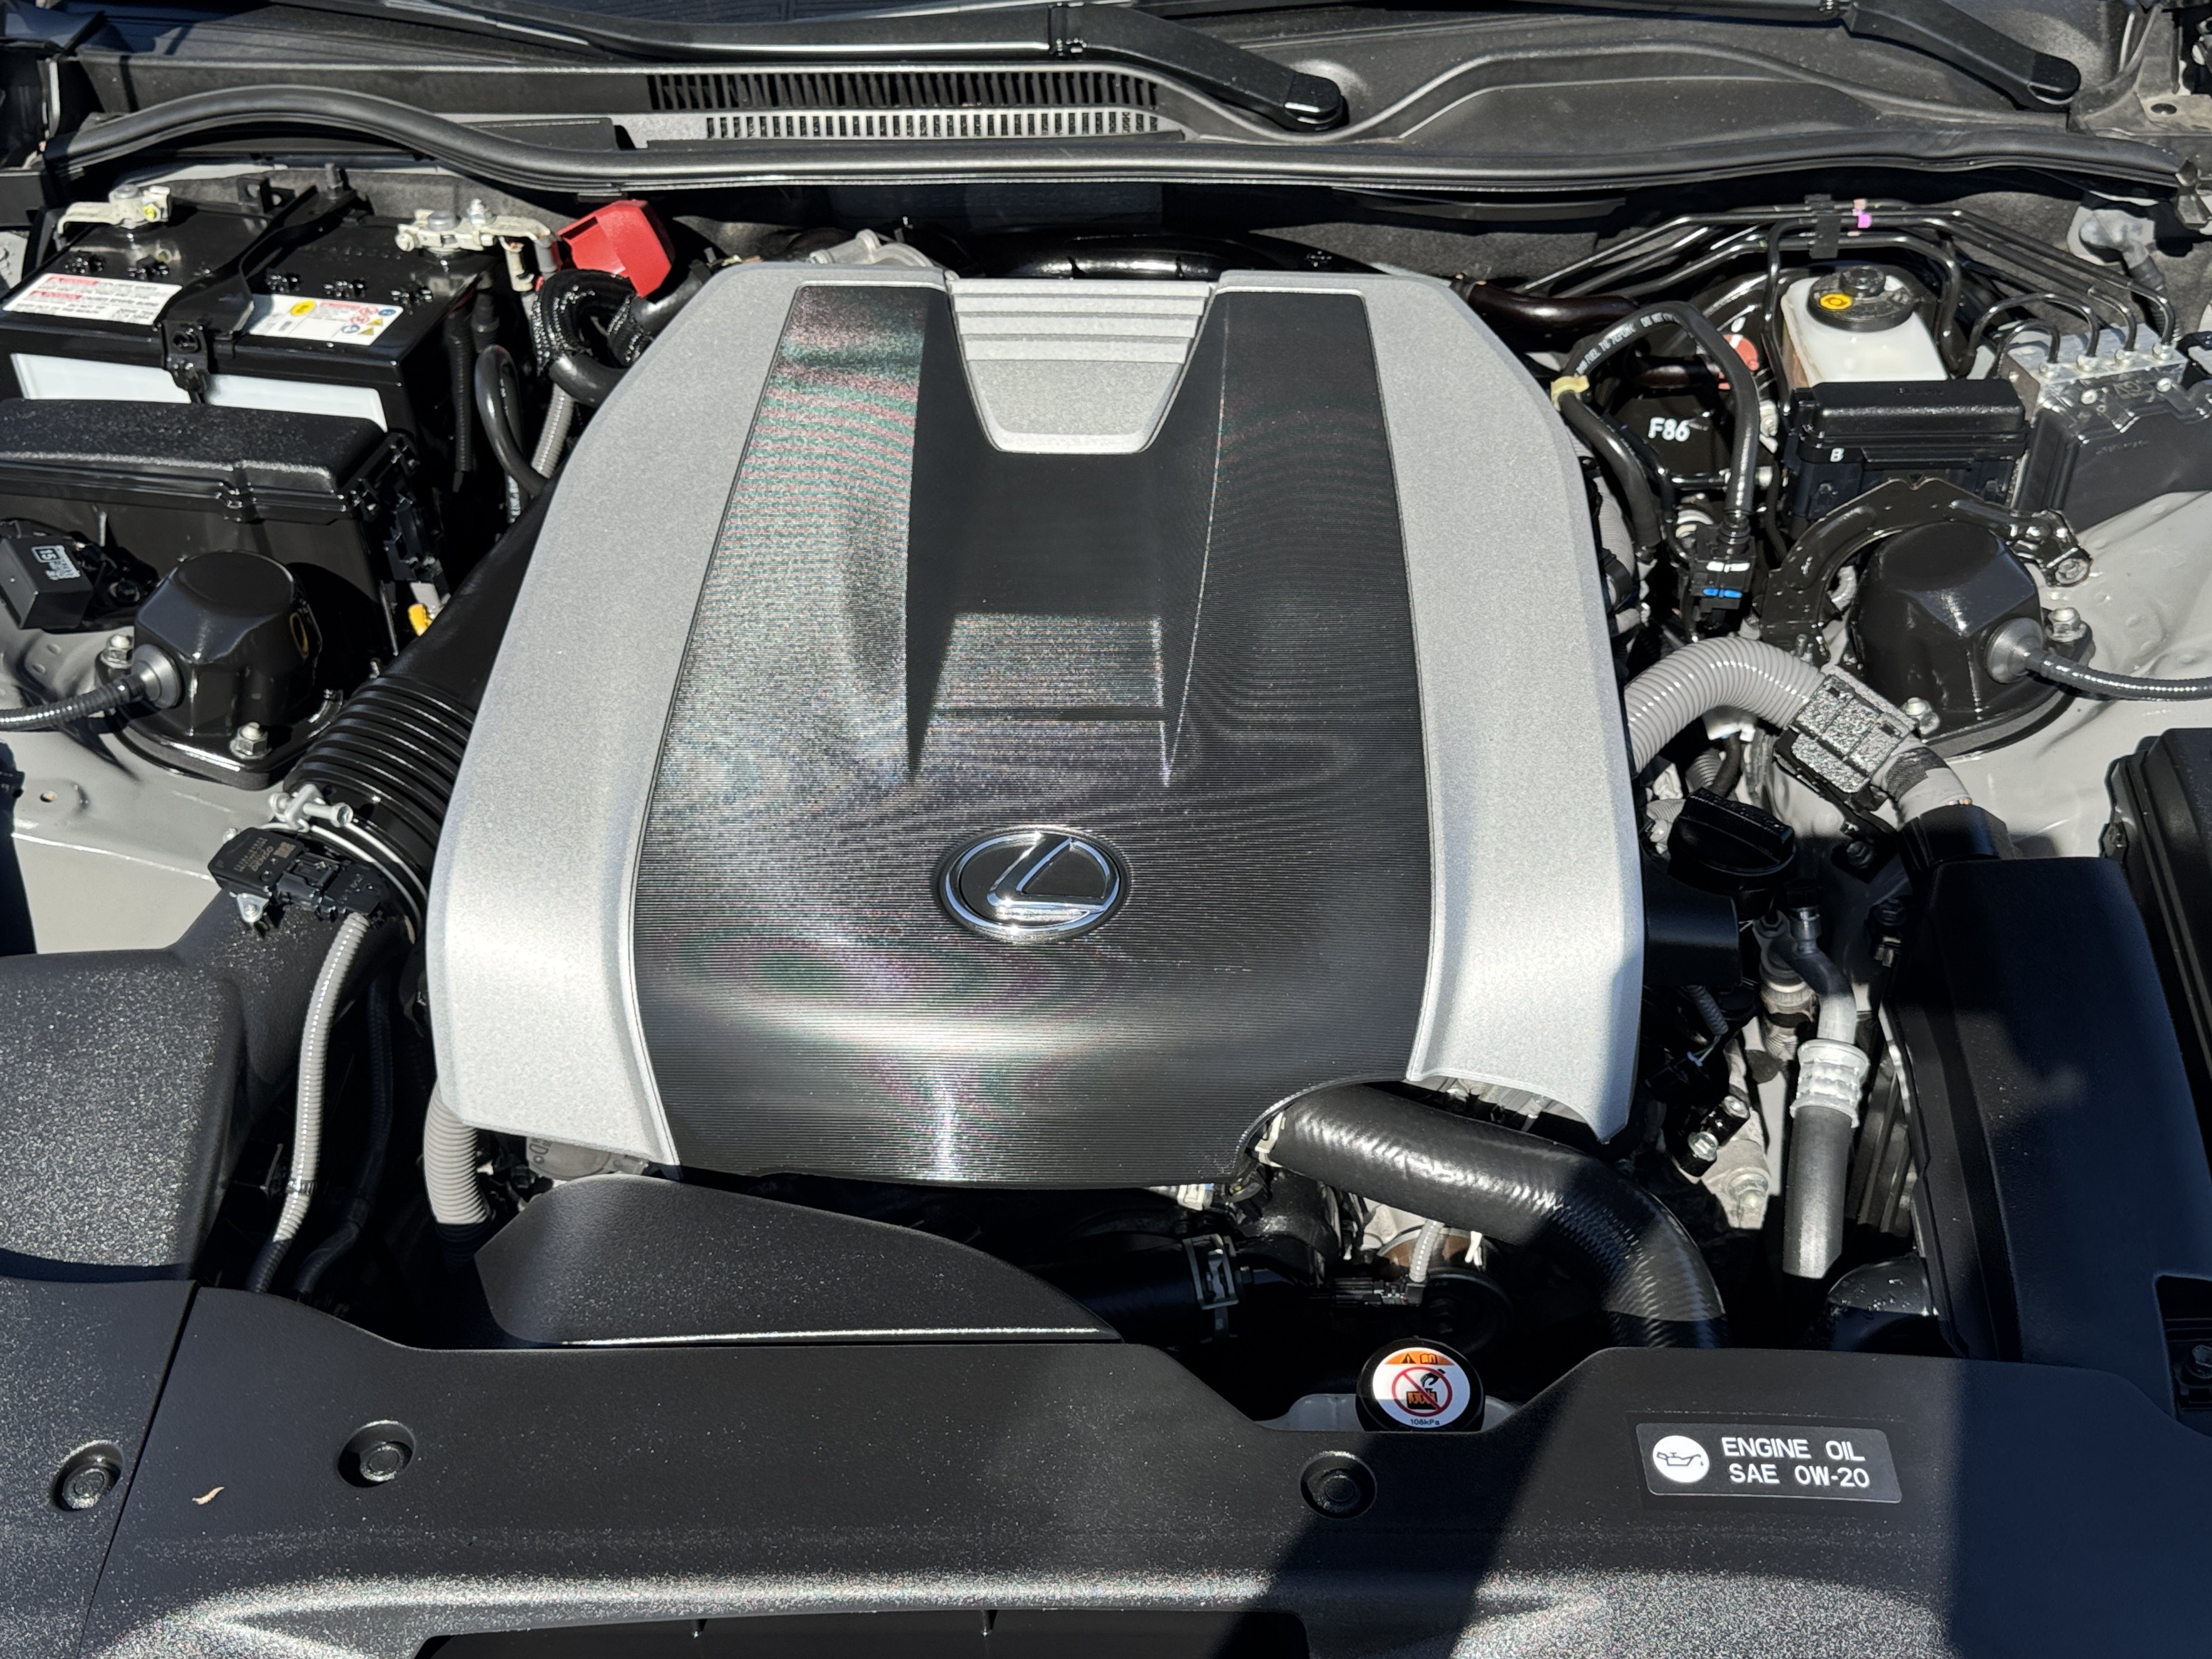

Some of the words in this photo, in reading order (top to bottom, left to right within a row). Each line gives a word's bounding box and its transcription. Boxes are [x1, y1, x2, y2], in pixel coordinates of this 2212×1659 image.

[1648, 417, 1690, 442] F86
[1830, 448, 1844, 462] B
[1721, 1436, 1811, 1459] ENGINE
[1825, 1440, 1865, 1462] OIL
[1729, 1463, 1780, 1483] SAE
[1795, 1465, 1870, 1488] 0W-20
